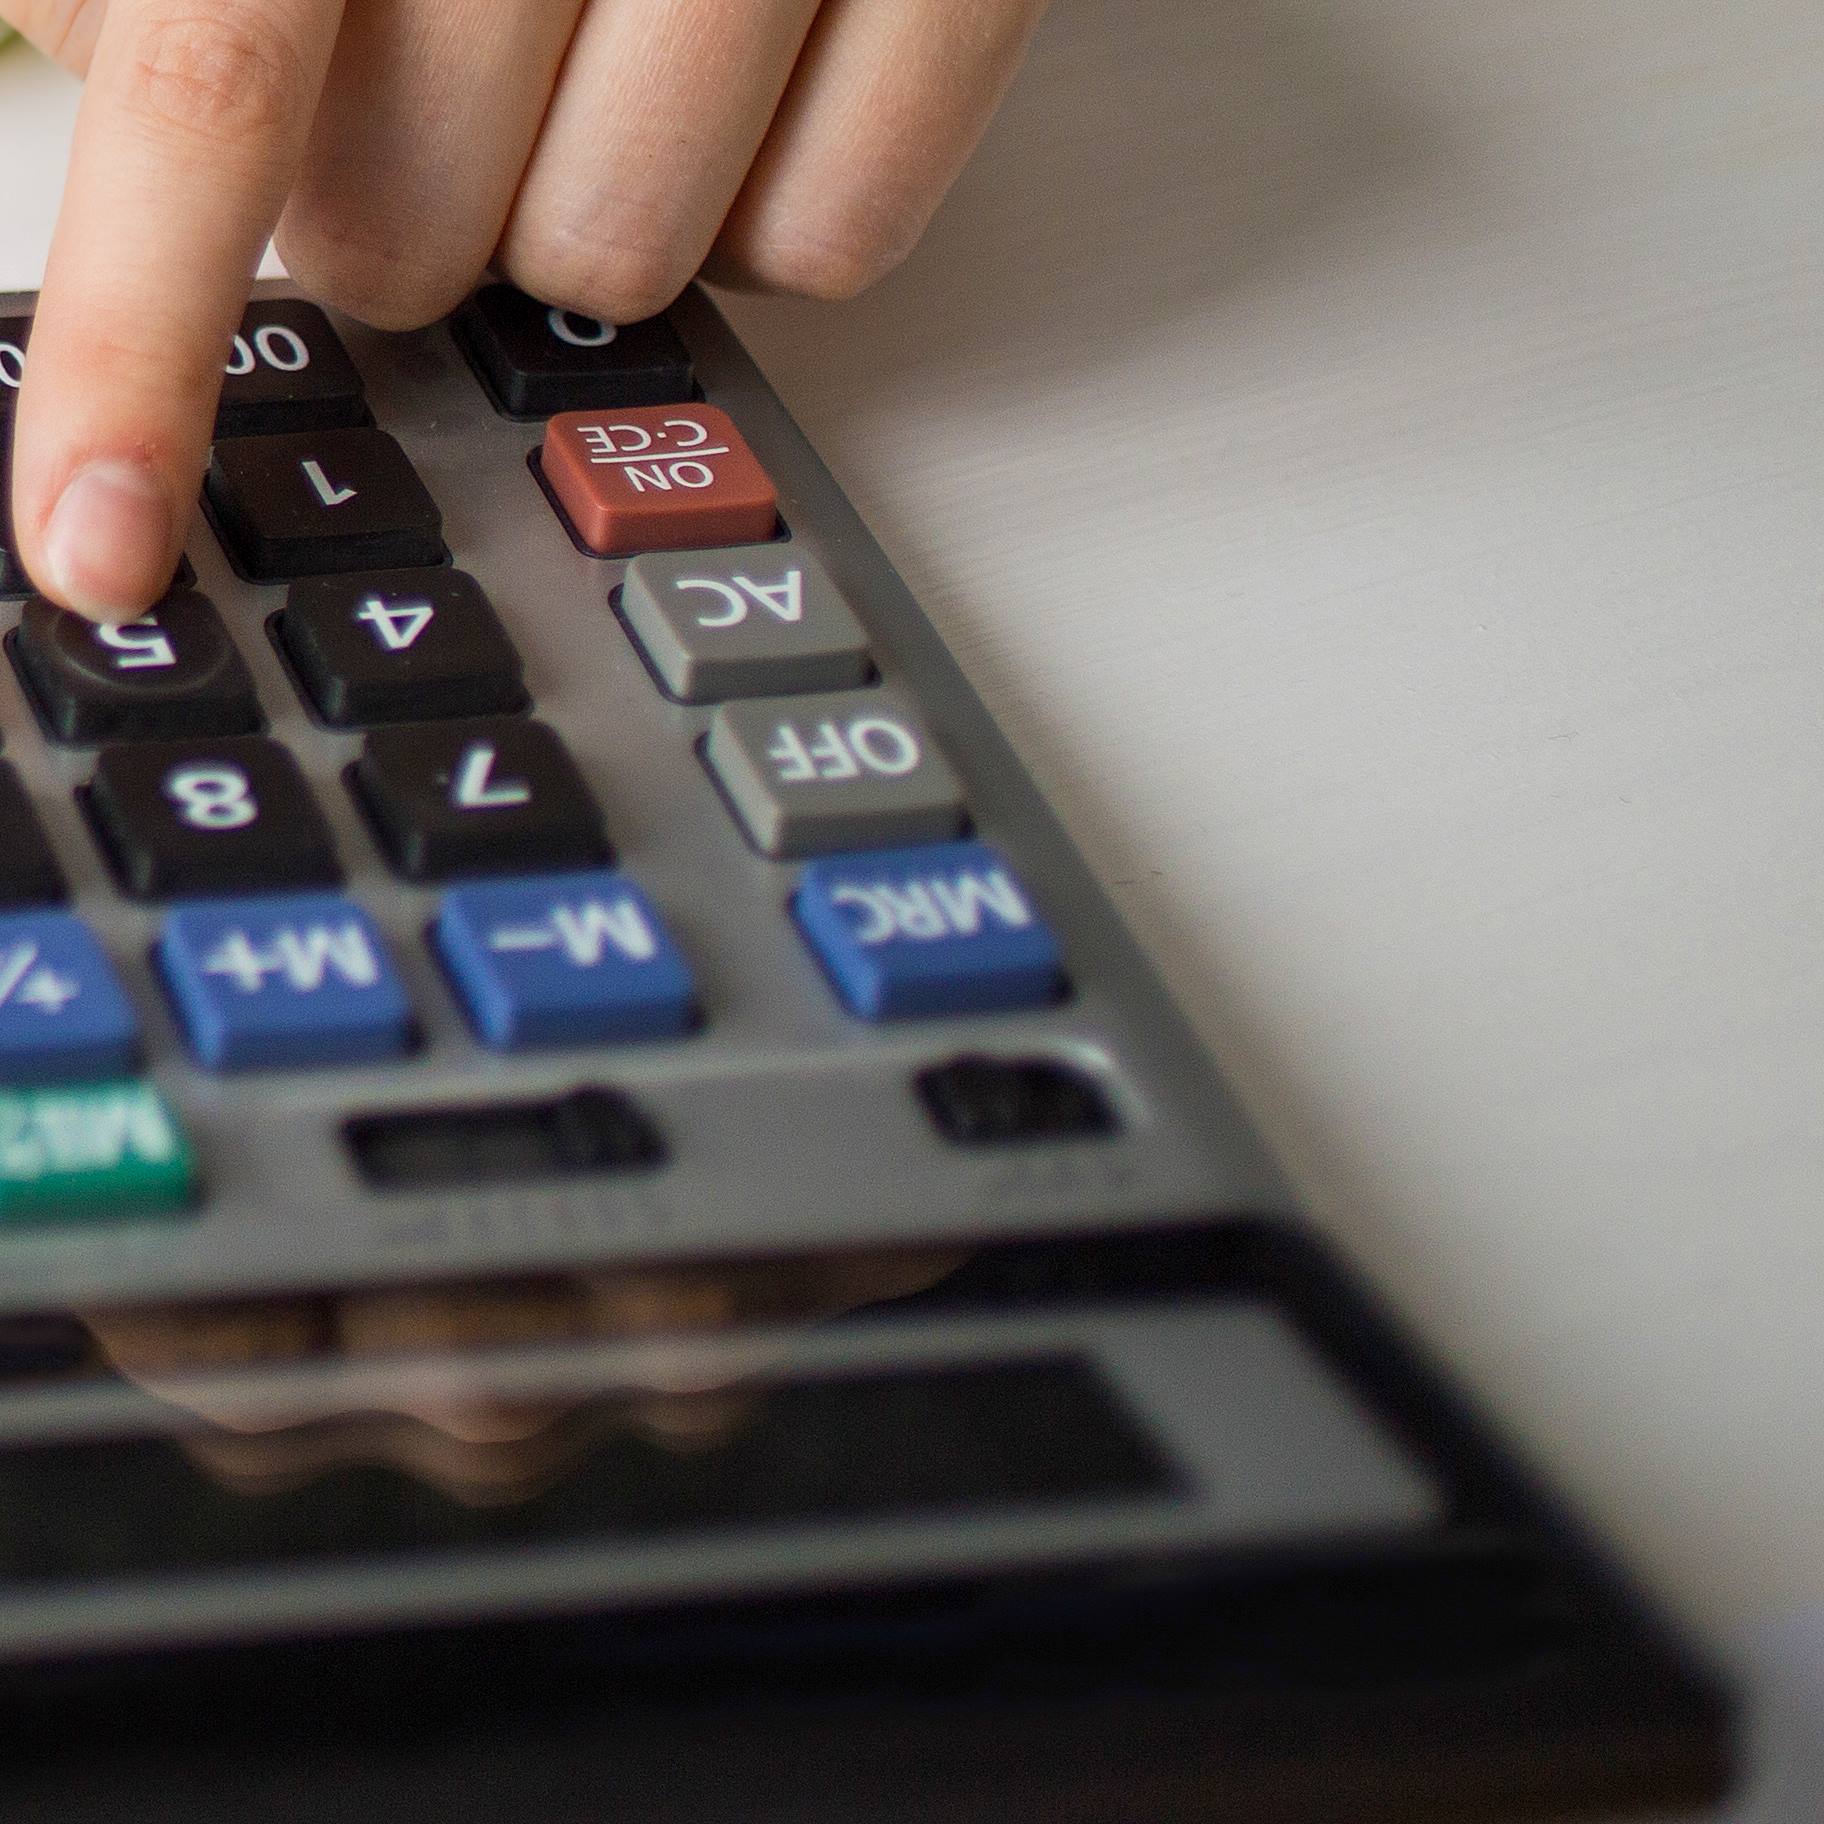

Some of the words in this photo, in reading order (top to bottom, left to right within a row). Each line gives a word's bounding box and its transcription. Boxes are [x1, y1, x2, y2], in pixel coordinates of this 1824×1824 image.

[300, 459, 358, 507] 1
[623, 460, 715, 493] ON
[357, 597, 435, 651] 4
[674, 568, 804, 628] AC
[98, 617, 178, 669] 5
[455, 746, 530, 809] 7
[768, 715, 922, 783] OFF
[168, 767, 257, 829] 8
[832, 869, 1034, 947] MRC
[205, 921, 381, 992] M+
